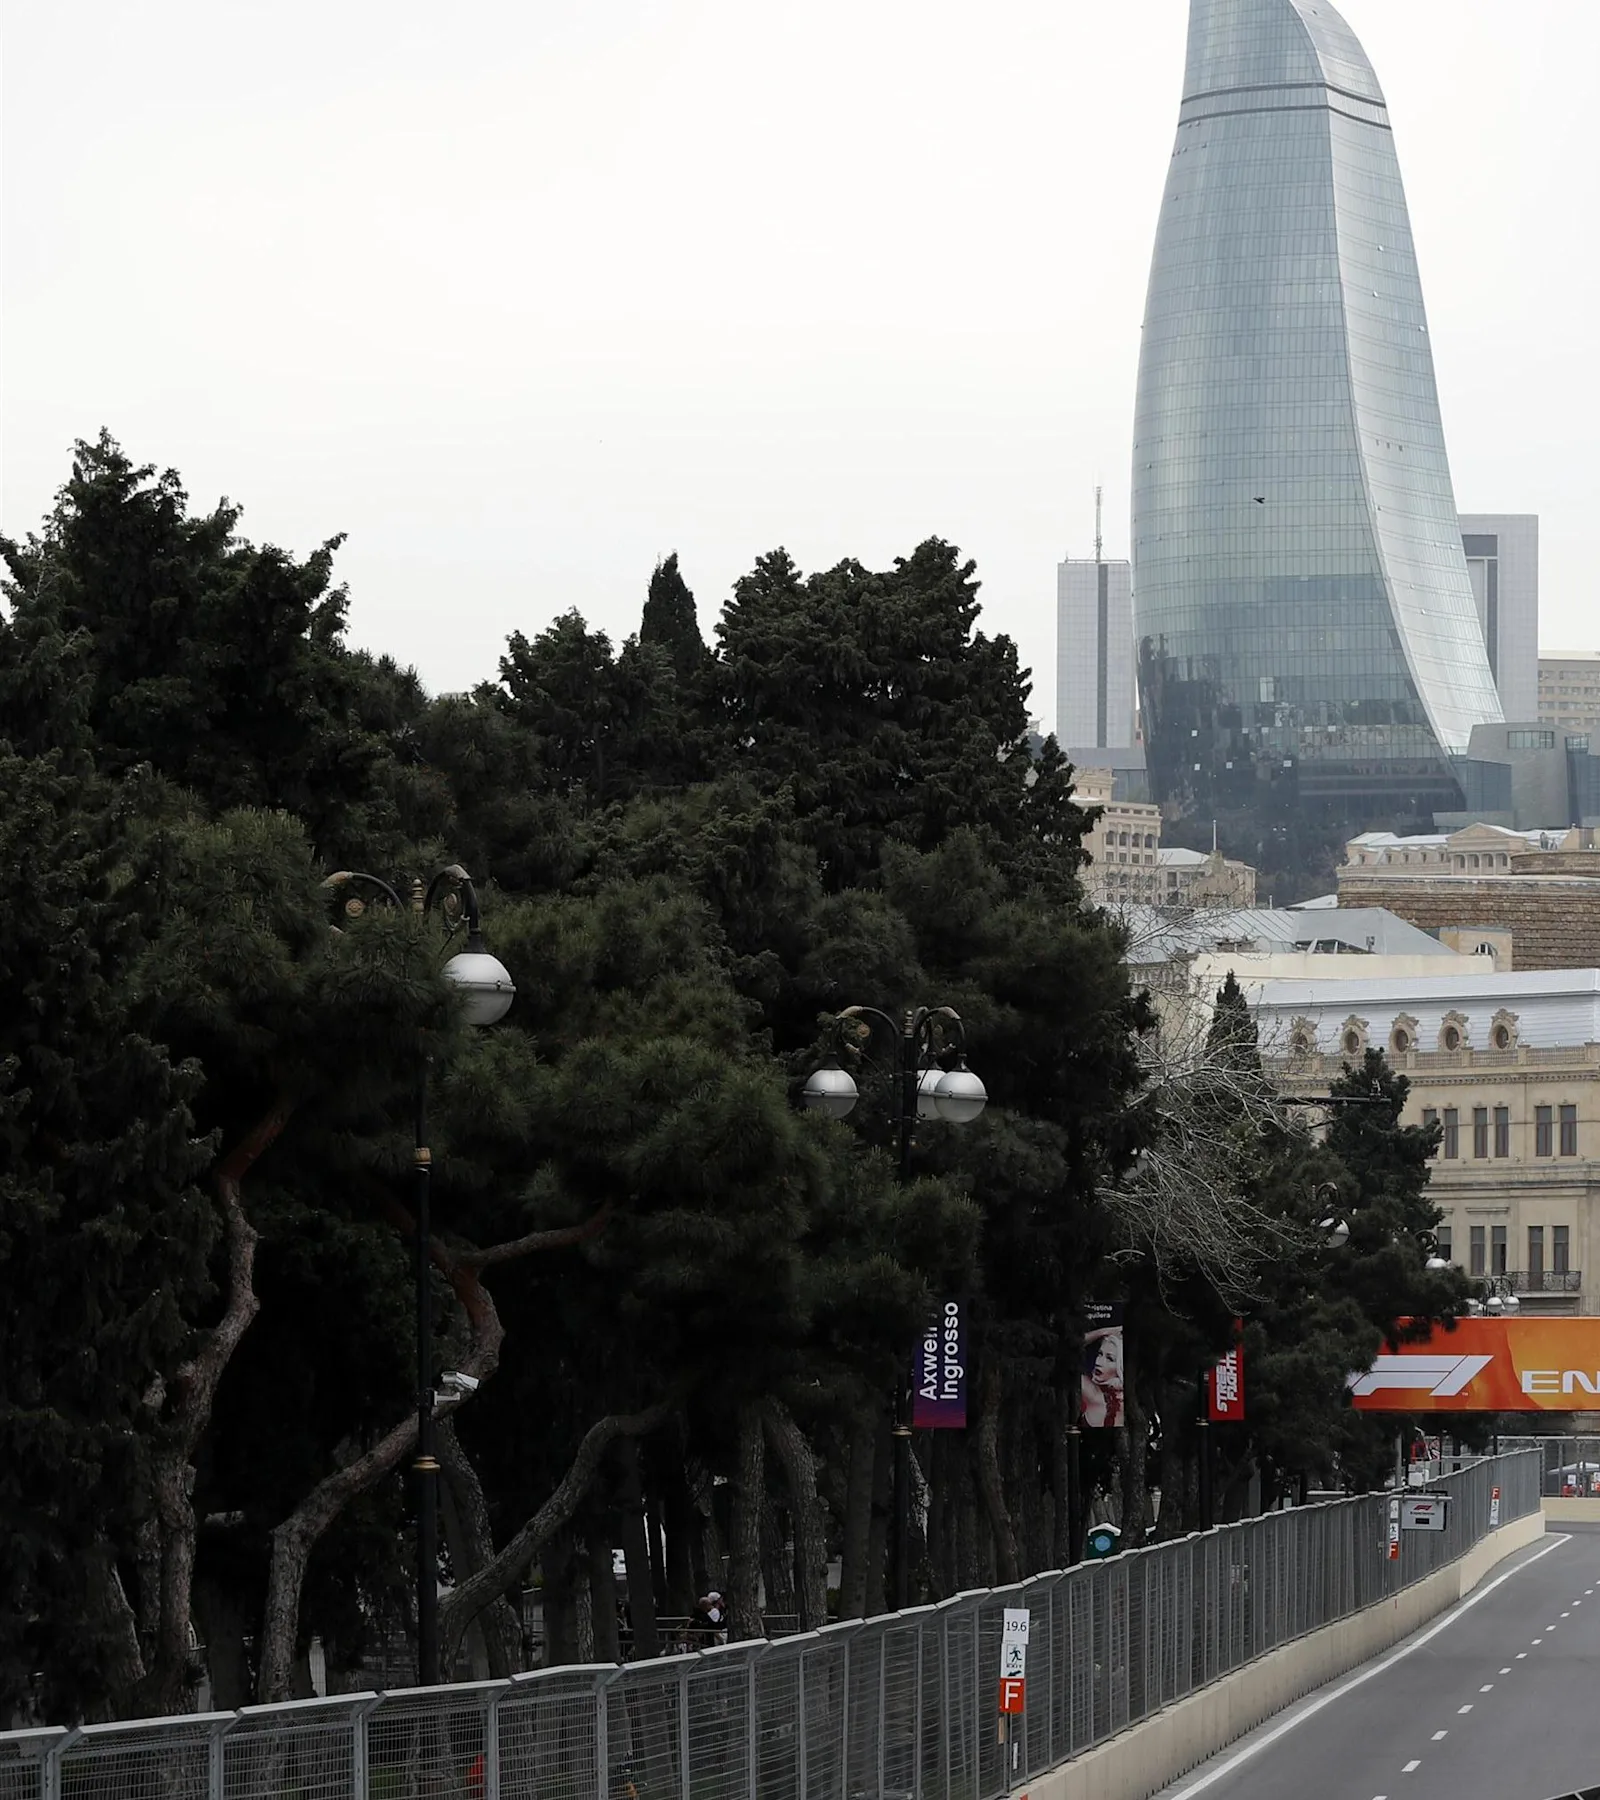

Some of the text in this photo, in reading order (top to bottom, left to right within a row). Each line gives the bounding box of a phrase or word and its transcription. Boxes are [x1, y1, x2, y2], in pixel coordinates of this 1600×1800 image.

[940, 1302, 964, 1399] Ingrosso
[1492, 1488, 1498, 1497] F
[1388, 1542, 1397, 1556] F
[1006, 1621, 1027, 1632] 19.6
[1004, 1681, 1021, 1709] F
